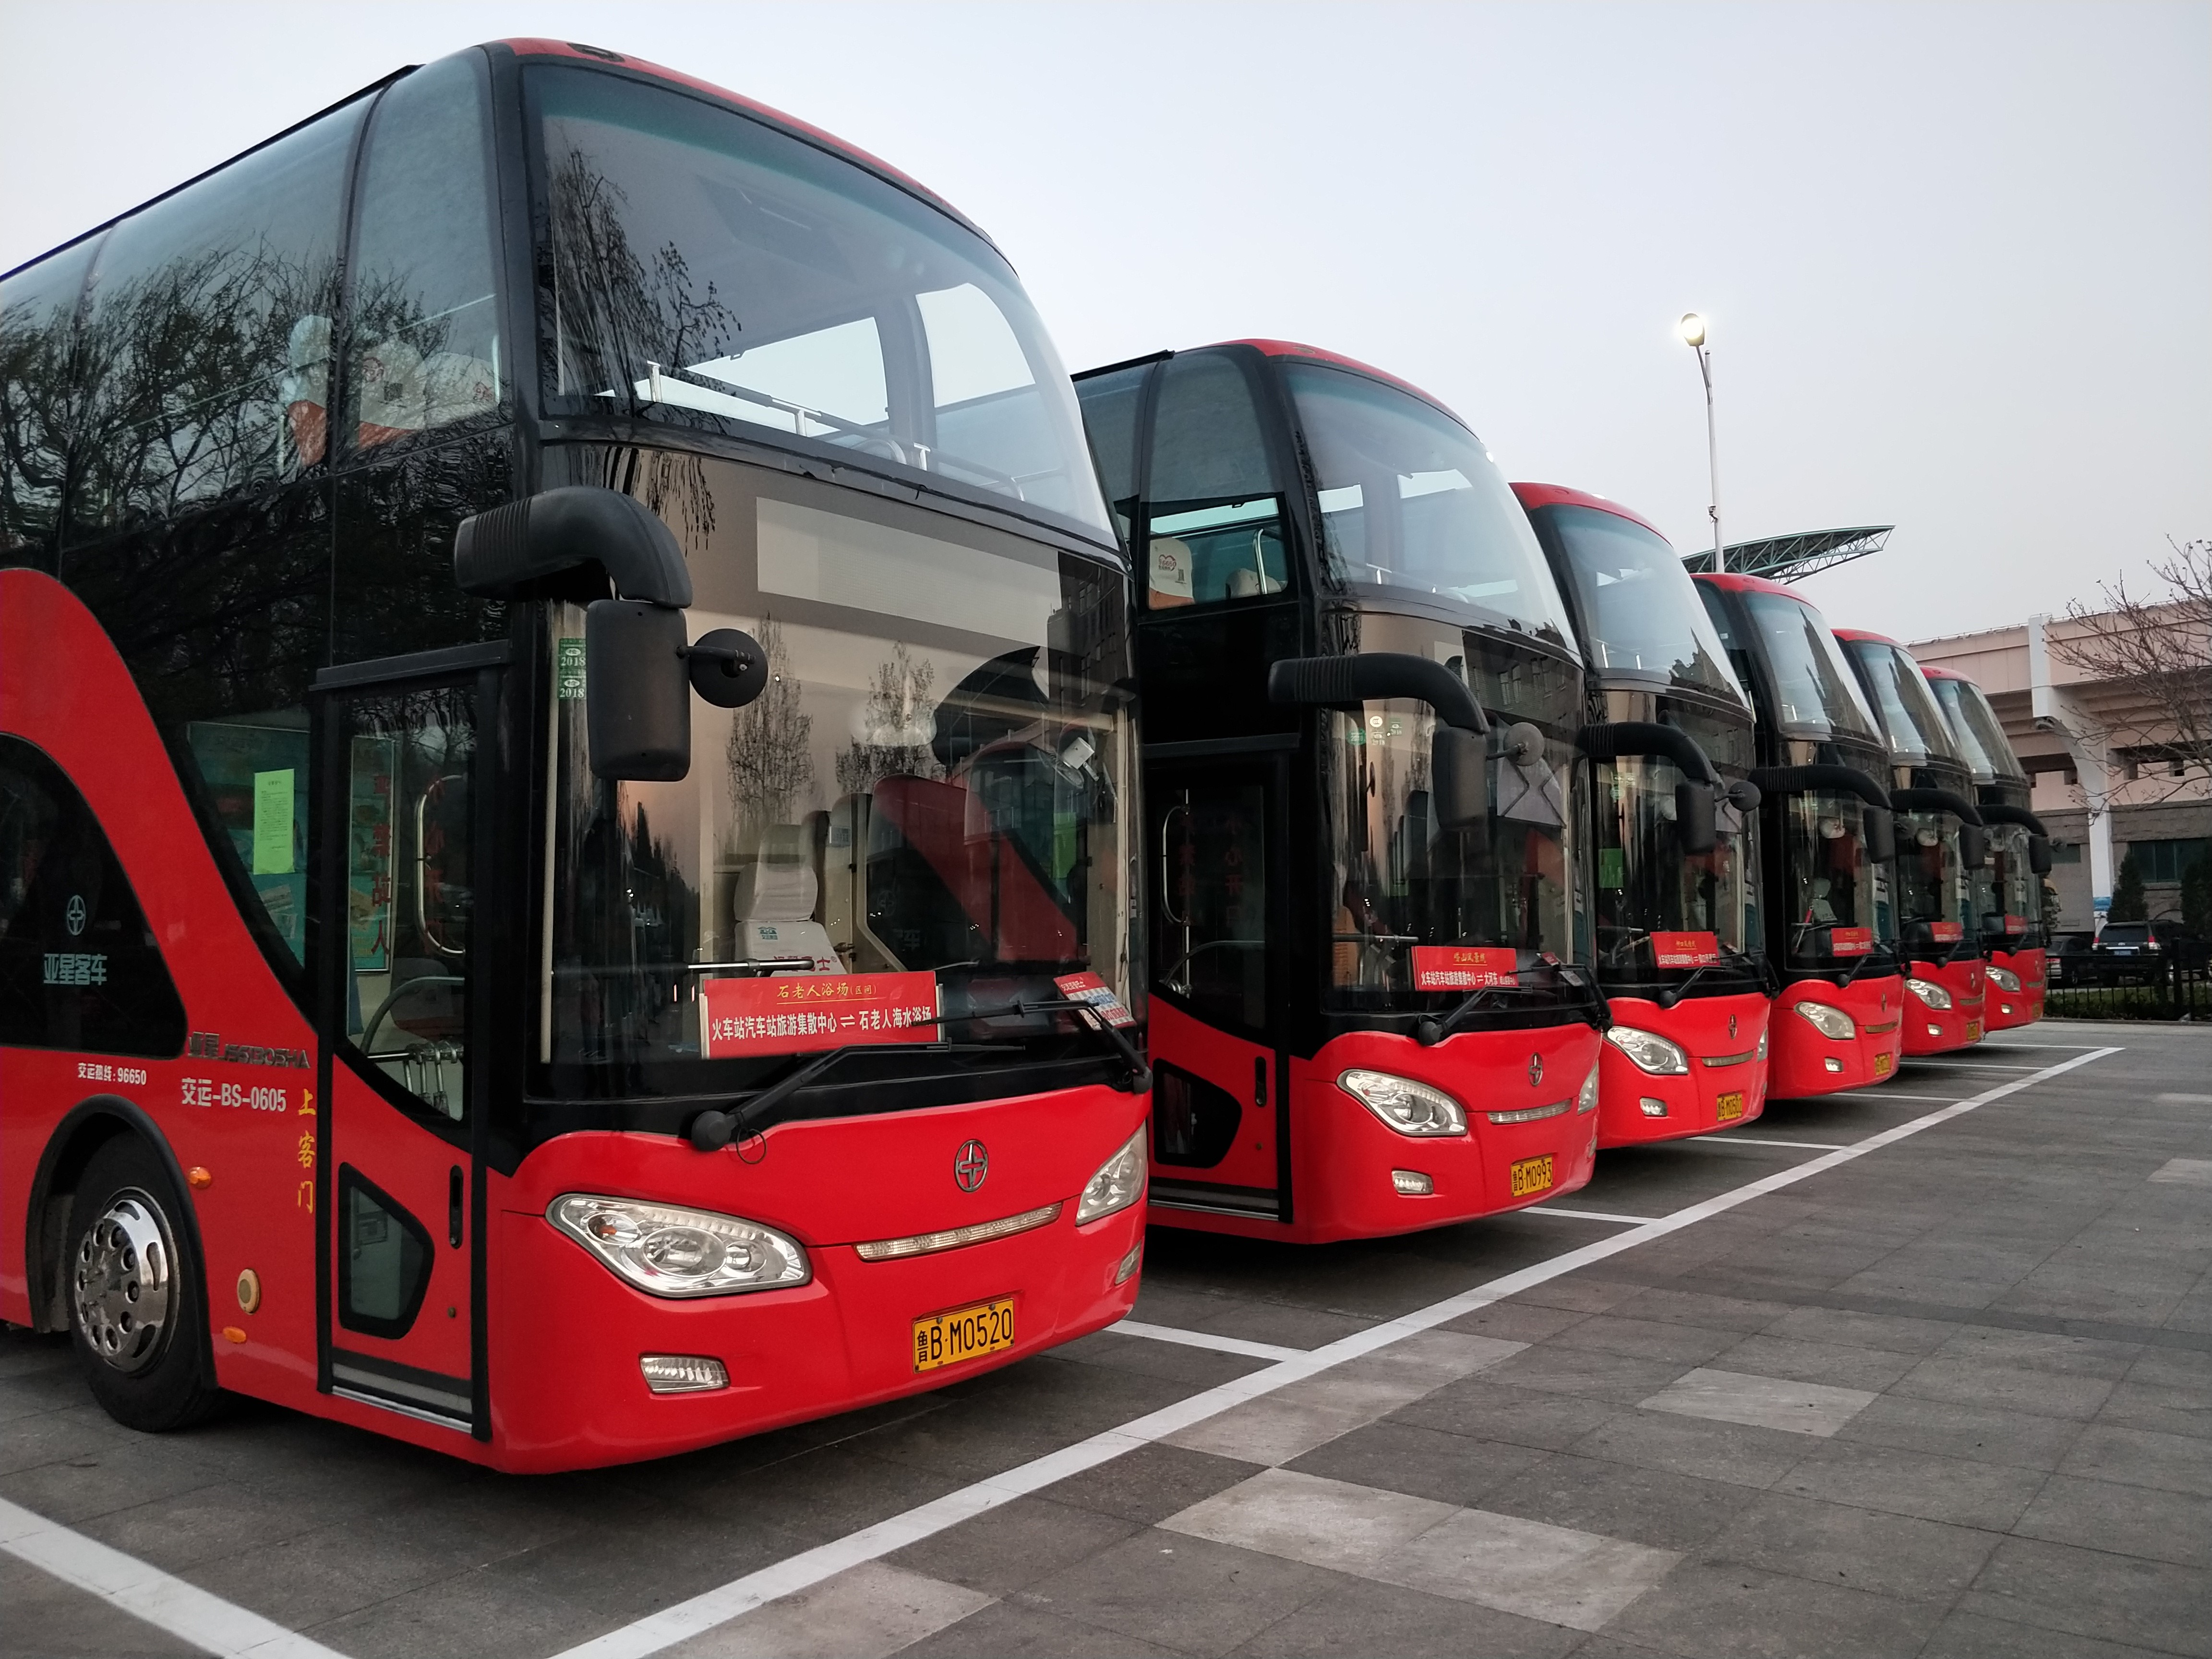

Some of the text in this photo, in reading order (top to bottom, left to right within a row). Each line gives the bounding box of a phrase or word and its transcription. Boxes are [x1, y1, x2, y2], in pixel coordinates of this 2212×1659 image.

[561, 657, 586, 666] 2018
[559, 688, 585, 698] 2018
[43, 953, 108, 986] 亚星客车
[712, 1006, 932, 1041] 火车站汽车站旅游集散中心 石老人海水浴场
[181, 1077, 287, 1112] 交运-BS-0605
[298, 1088, 316, 1214] 上客门
[917, 1308, 1012, 1363] 鲁B·M0520
